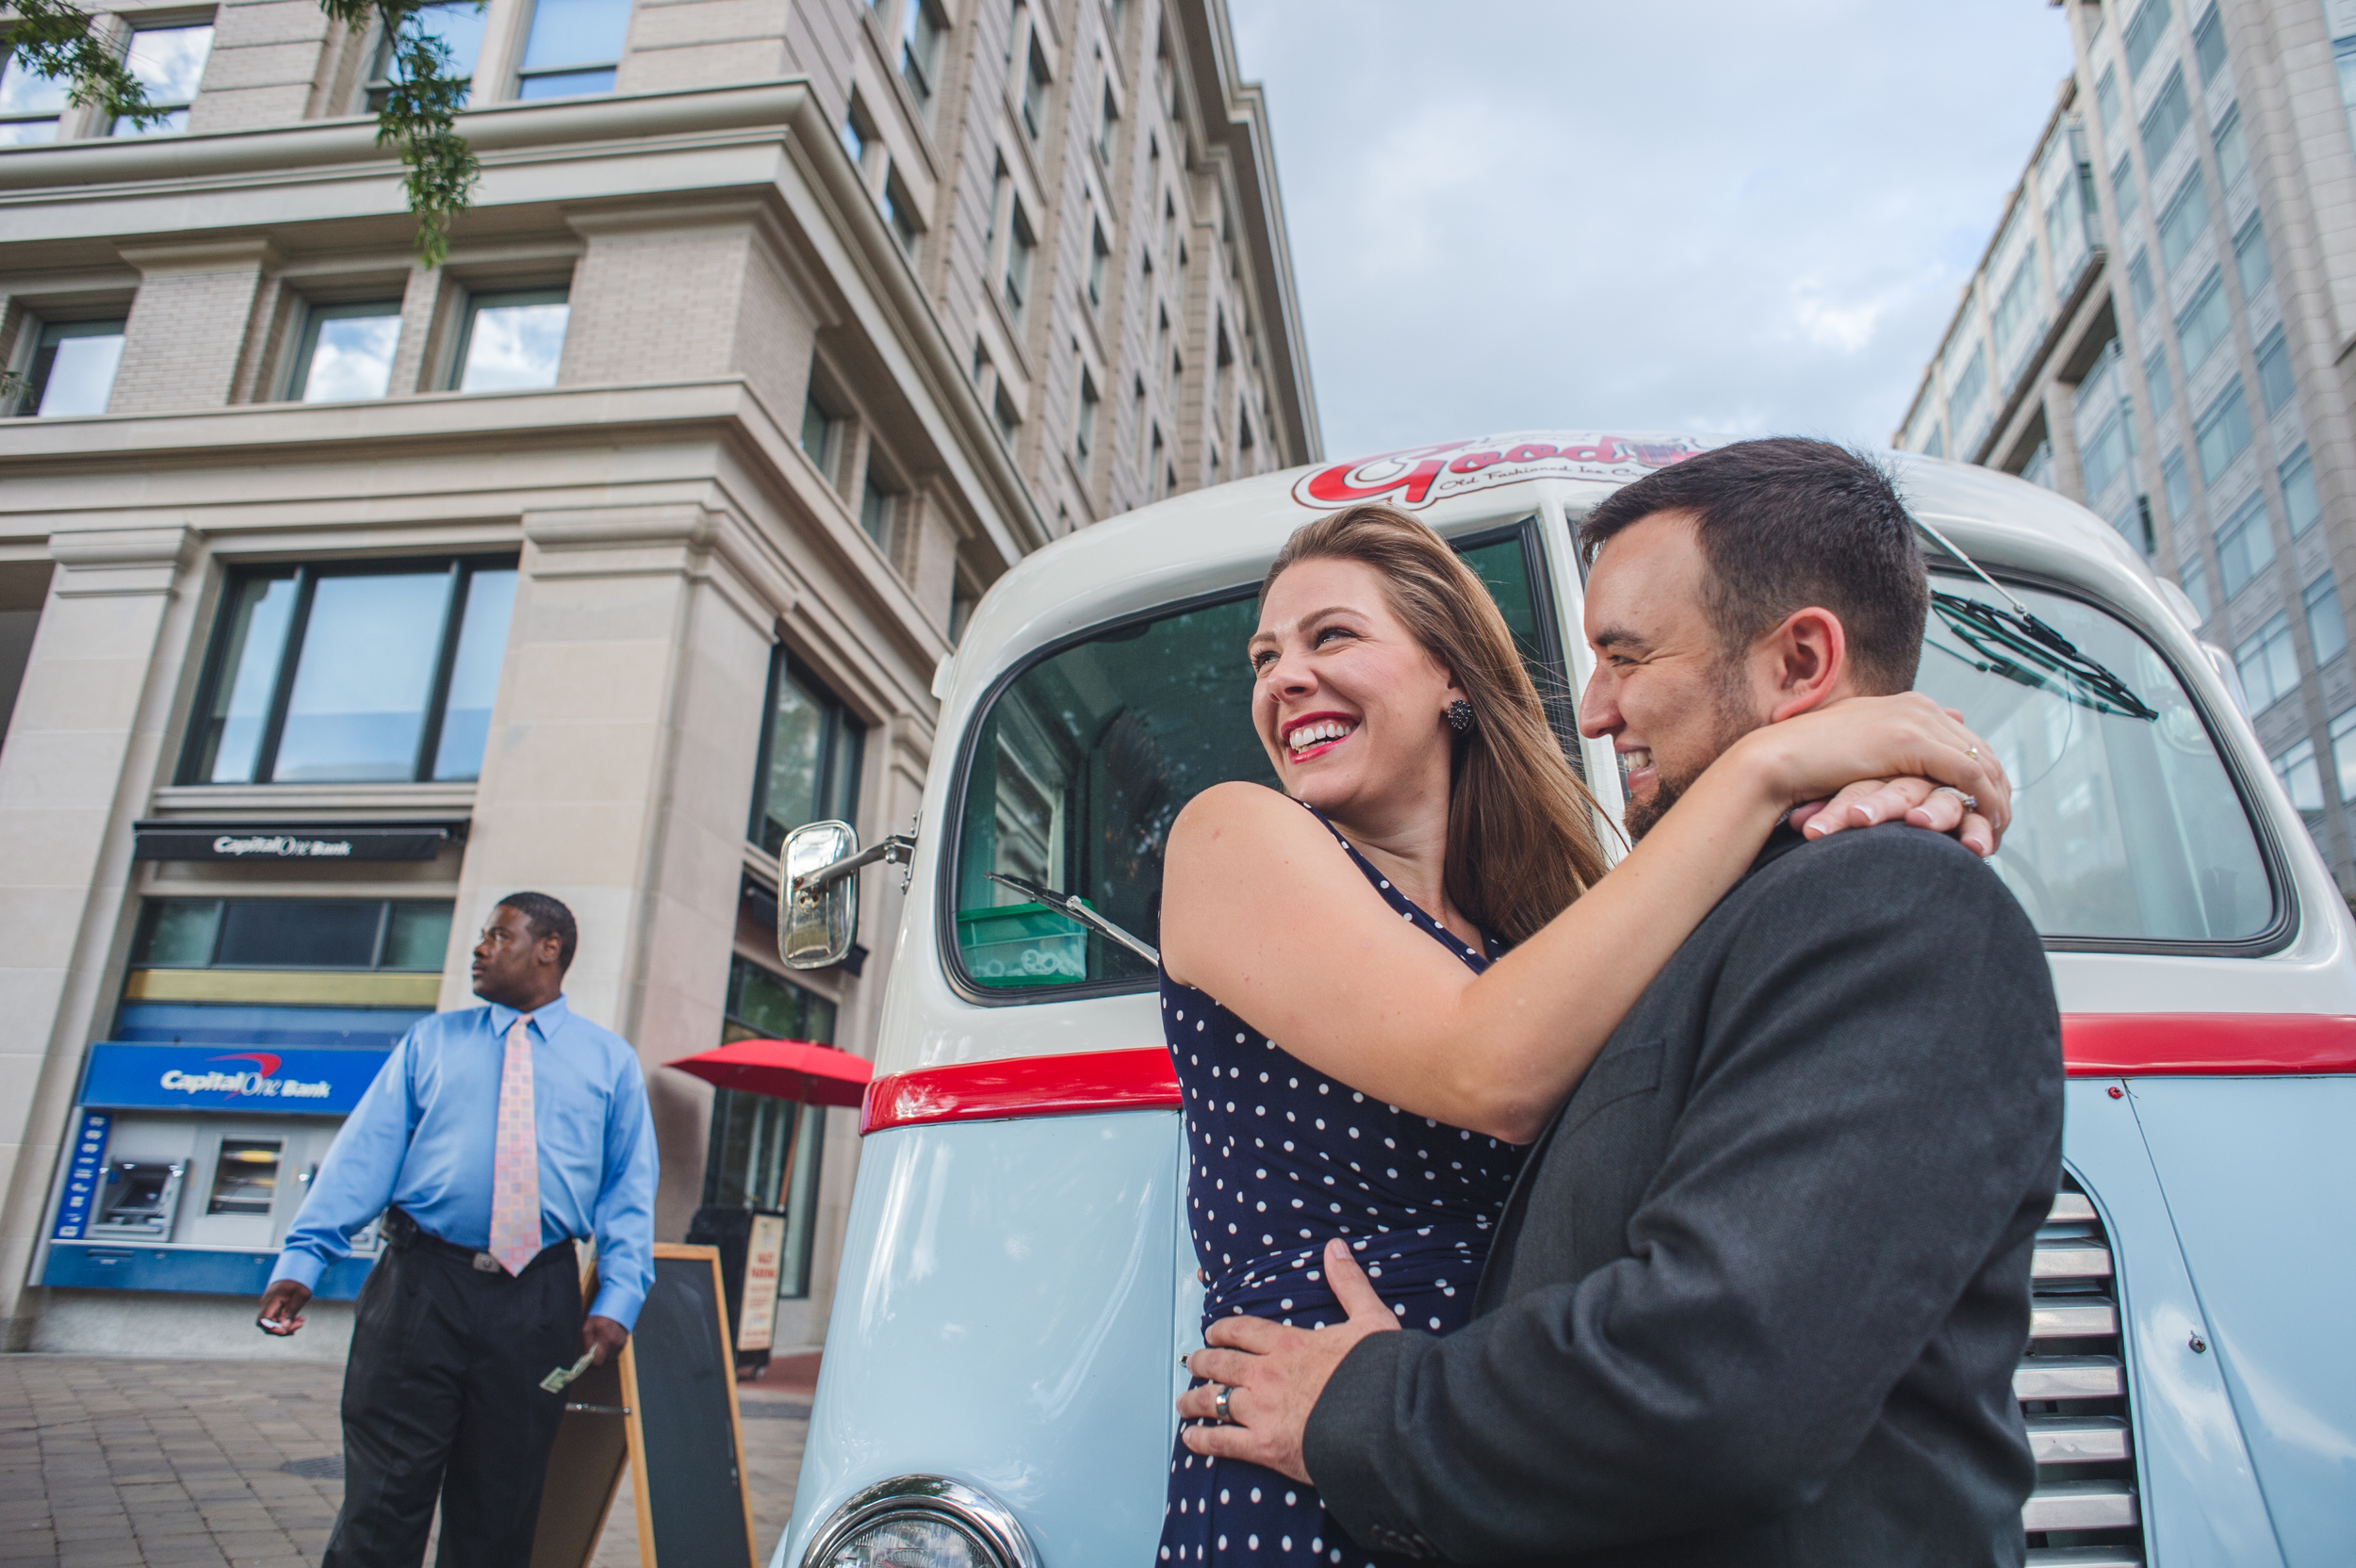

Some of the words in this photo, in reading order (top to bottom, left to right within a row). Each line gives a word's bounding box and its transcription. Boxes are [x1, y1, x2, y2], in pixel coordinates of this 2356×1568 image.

[1439, 477, 1480, 490] Old
[1483, 466, 1572, 480] Fashioned
[309, 841, 353, 856] Bank
[281, 1079, 331, 1098] Bank
